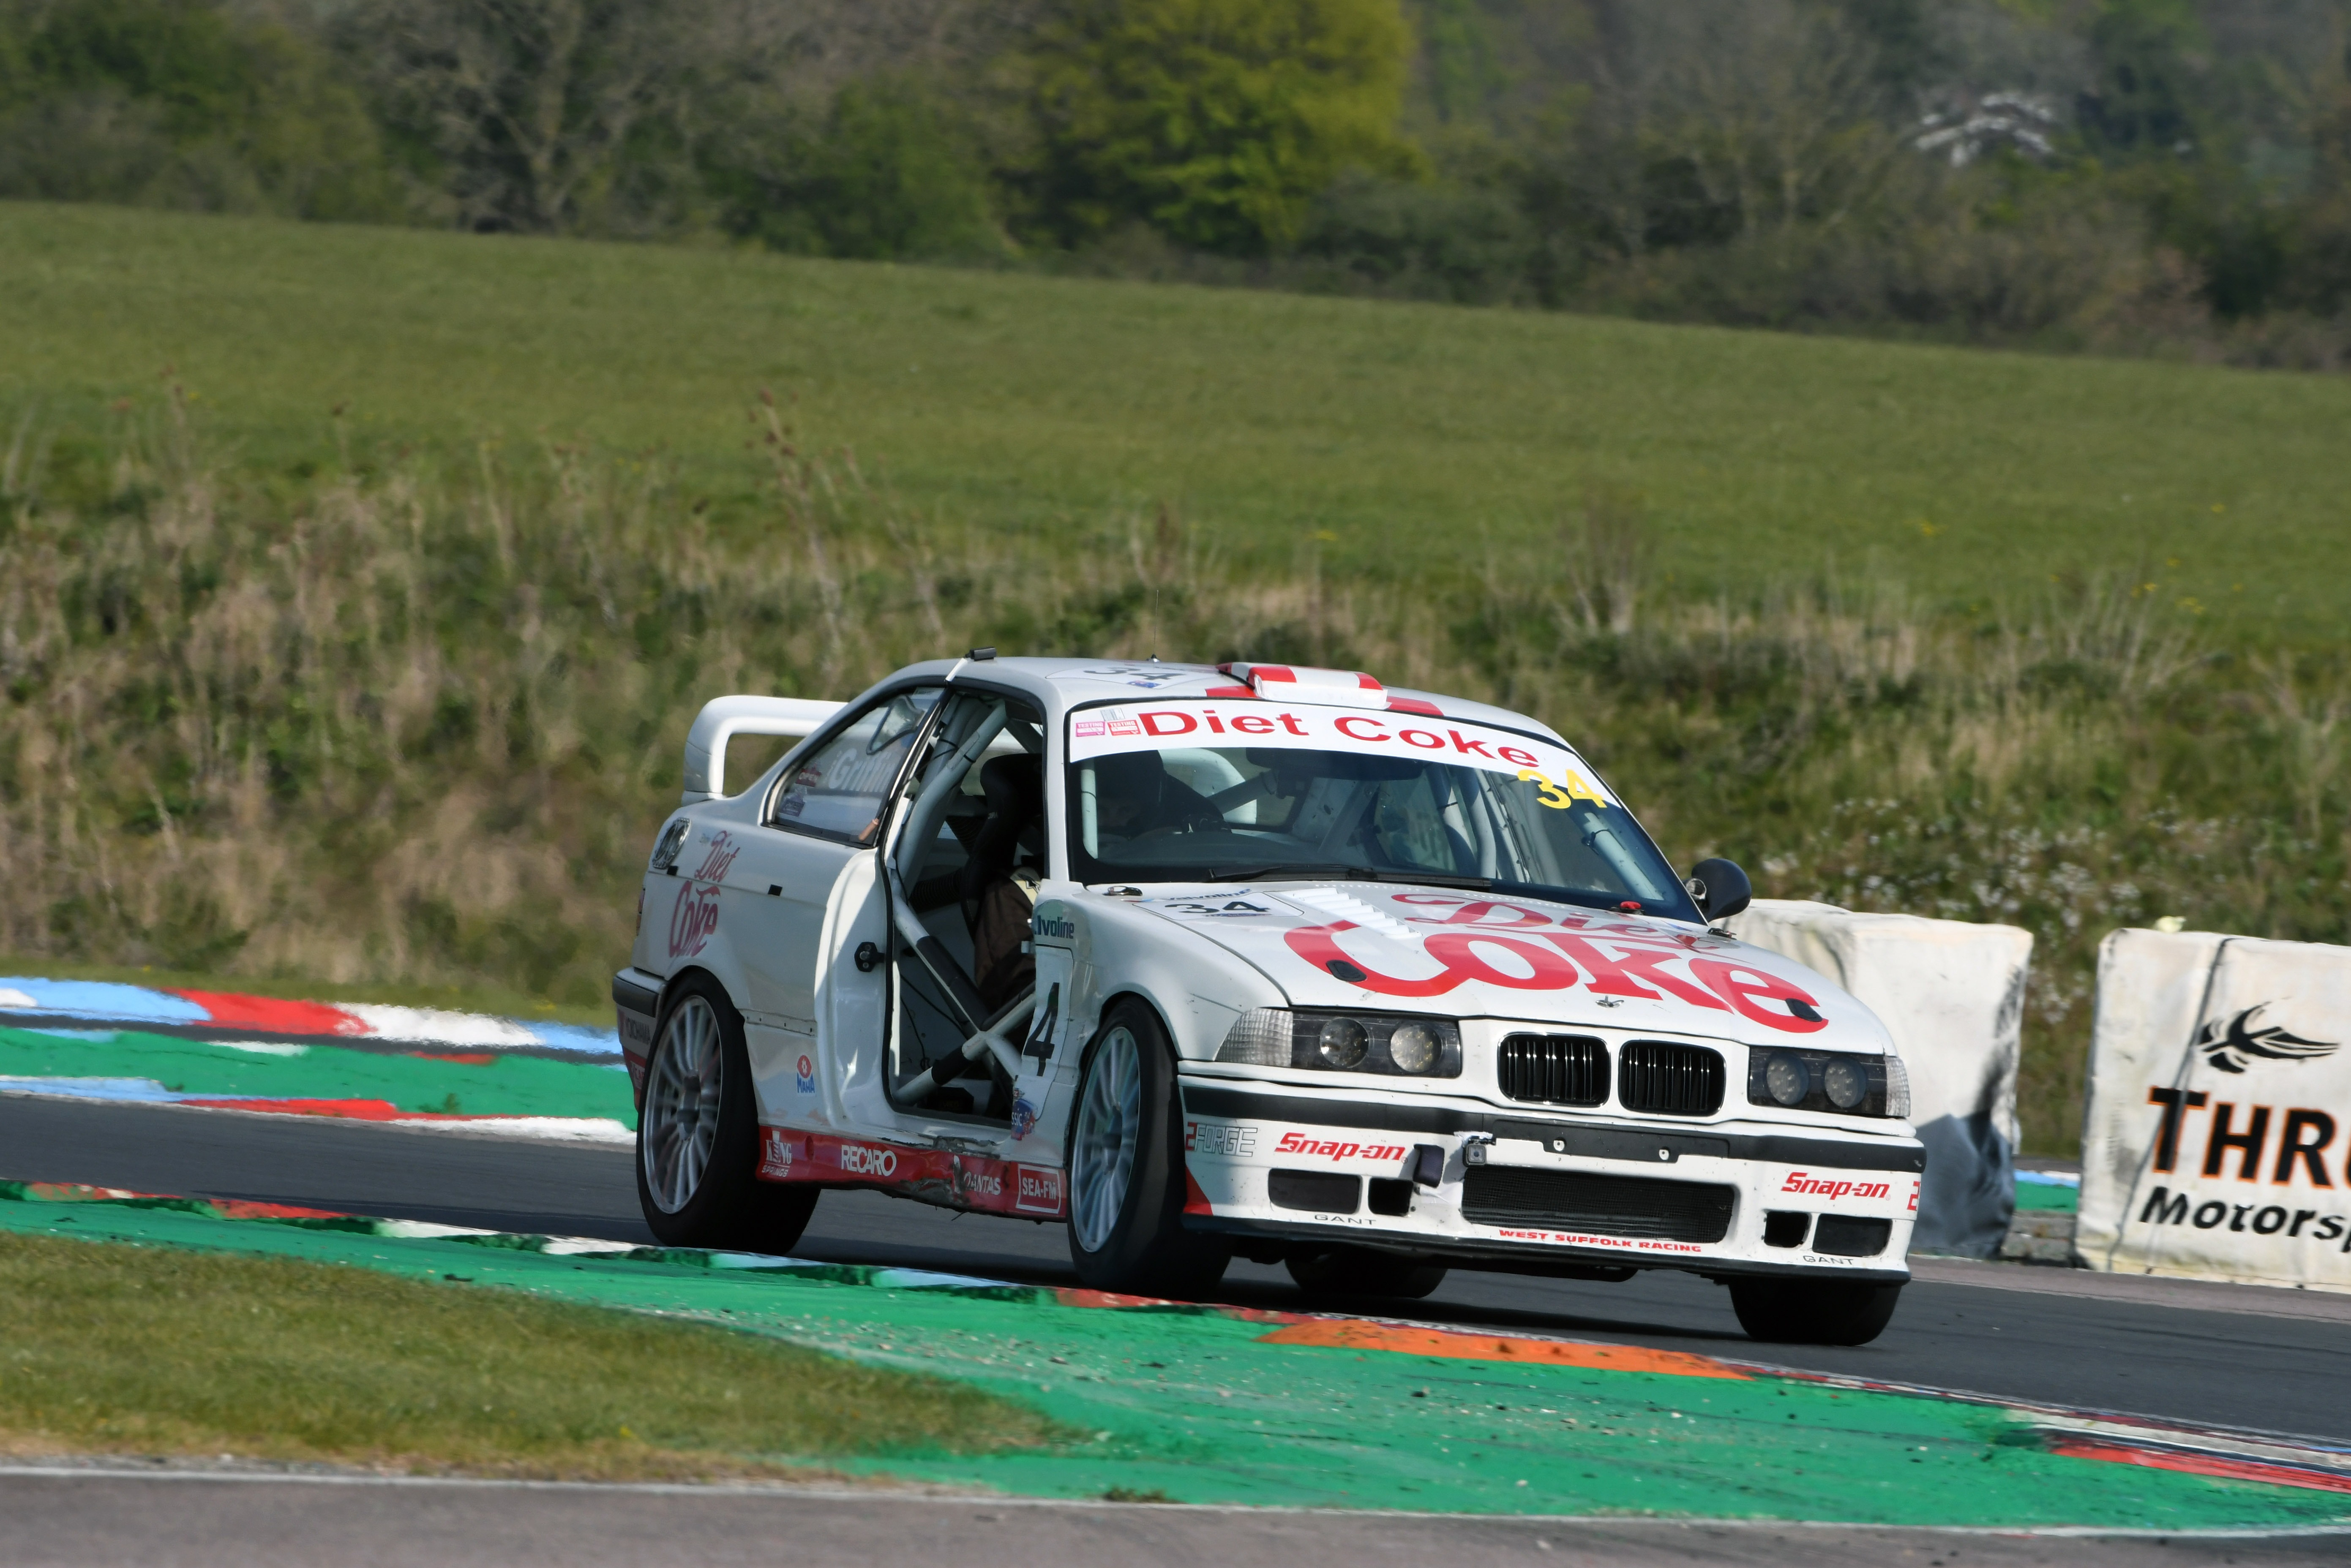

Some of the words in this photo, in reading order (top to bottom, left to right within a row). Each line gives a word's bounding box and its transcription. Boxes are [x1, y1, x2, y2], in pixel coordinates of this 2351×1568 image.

[1083, 667, 1185, 680] 34
[1138, 709, 1309, 737] Diet
[1334, 716, 1539, 768] Coke
[1517, 768, 1607, 810] 34
[694, 830, 740, 882] Diet
[669, 880, 720, 958] Coke
[1165, 901, 1271, 914] 34
[1034, 915, 1075, 939] lvoline
[1284, 920, 1829, 1033] Coke
[797, 1072, 815, 1093] MAHA
[1274, 1132, 1406, 1161] Snap-on
[2147, 1085, 2351, 1190] THR
[762, 1165, 788, 1178] SPRINGS
[841, 1144, 897, 1176] RECARO
[1023, 1178, 1056, 1200] SEA-FM
[1781, 1172, 1890, 1200] Snap-on
[1315, 1214, 1376, 1225] GANT
[2139, 1185, 2351, 1253] Motors
[1499, 1230, 1548, 1239] WEST
[1555, 1234, 1632, 1247] SUFFOLK
[1639, 1241, 1702, 1252] RACING
[1803, 1255, 1854, 1265] GANT
